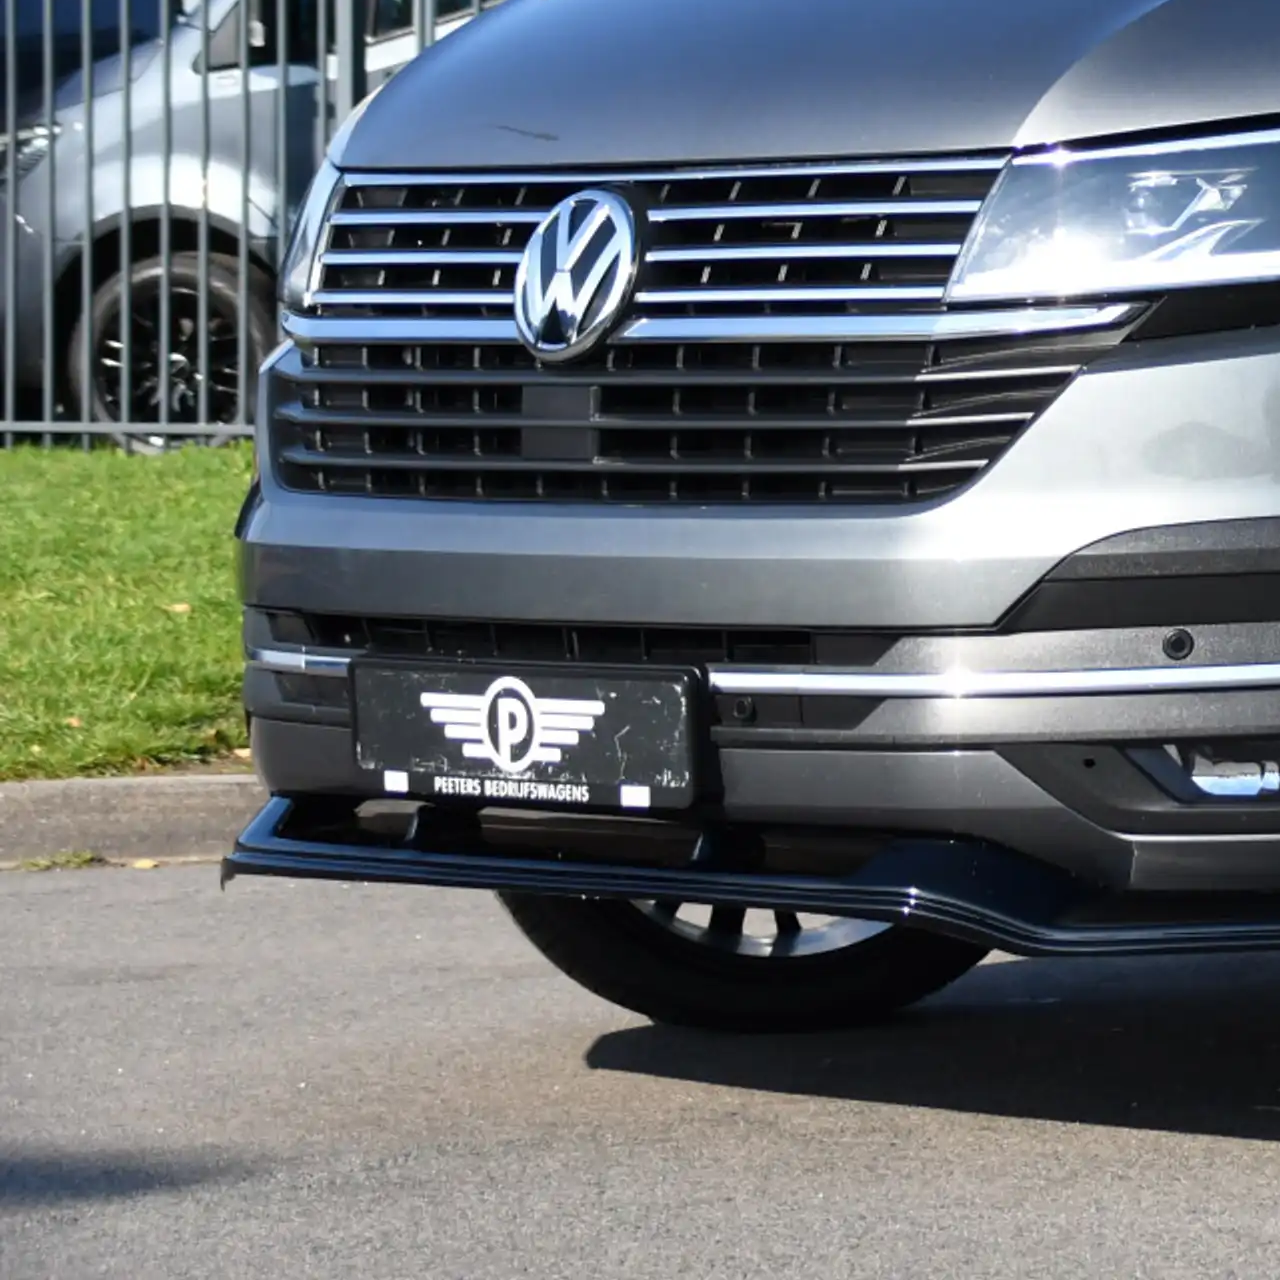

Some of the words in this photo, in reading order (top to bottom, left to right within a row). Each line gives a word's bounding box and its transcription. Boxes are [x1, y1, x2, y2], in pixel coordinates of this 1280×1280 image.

[514, 189, 637, 361] VW
[433, 776, 481, 795] PEETERS
[484, 779, 589, 802] BEDRIJFSWAGENS
